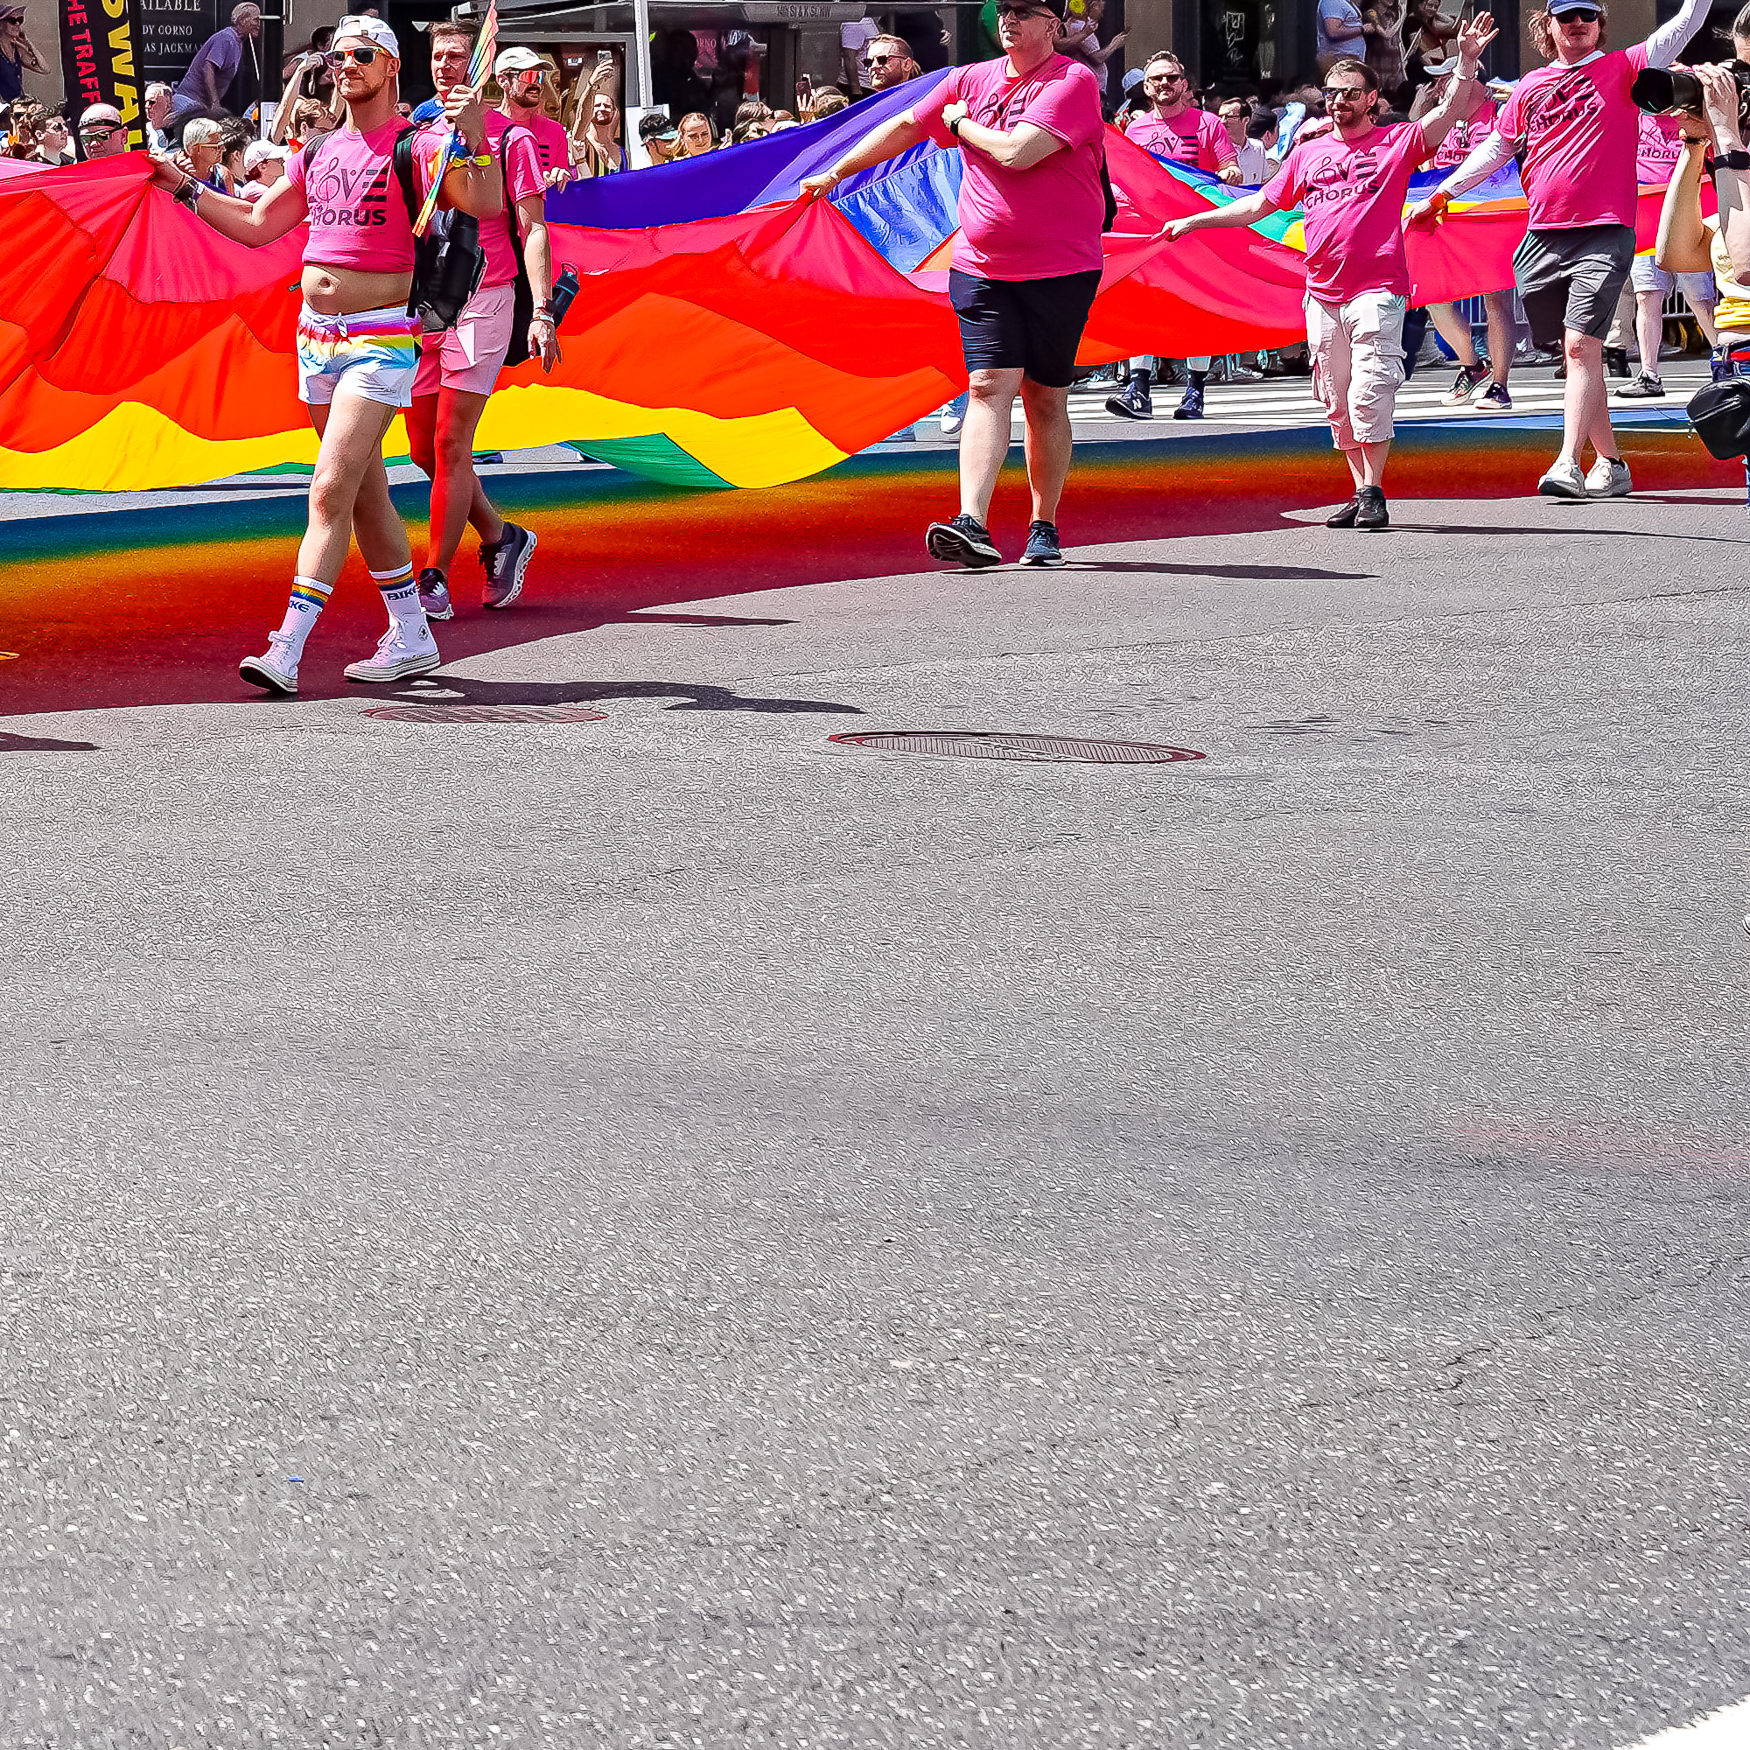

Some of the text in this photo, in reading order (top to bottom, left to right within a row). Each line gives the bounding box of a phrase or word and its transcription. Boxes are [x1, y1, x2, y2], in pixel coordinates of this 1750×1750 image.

[158, 24, 193, 36] CORNO
[158, 42, 203, 56] JACKMA
[71, 28, 102, 108] TRAFF
[1641, 148, 1680, 159] HORU
[1306, 180, 1379, 209] CHORUS
